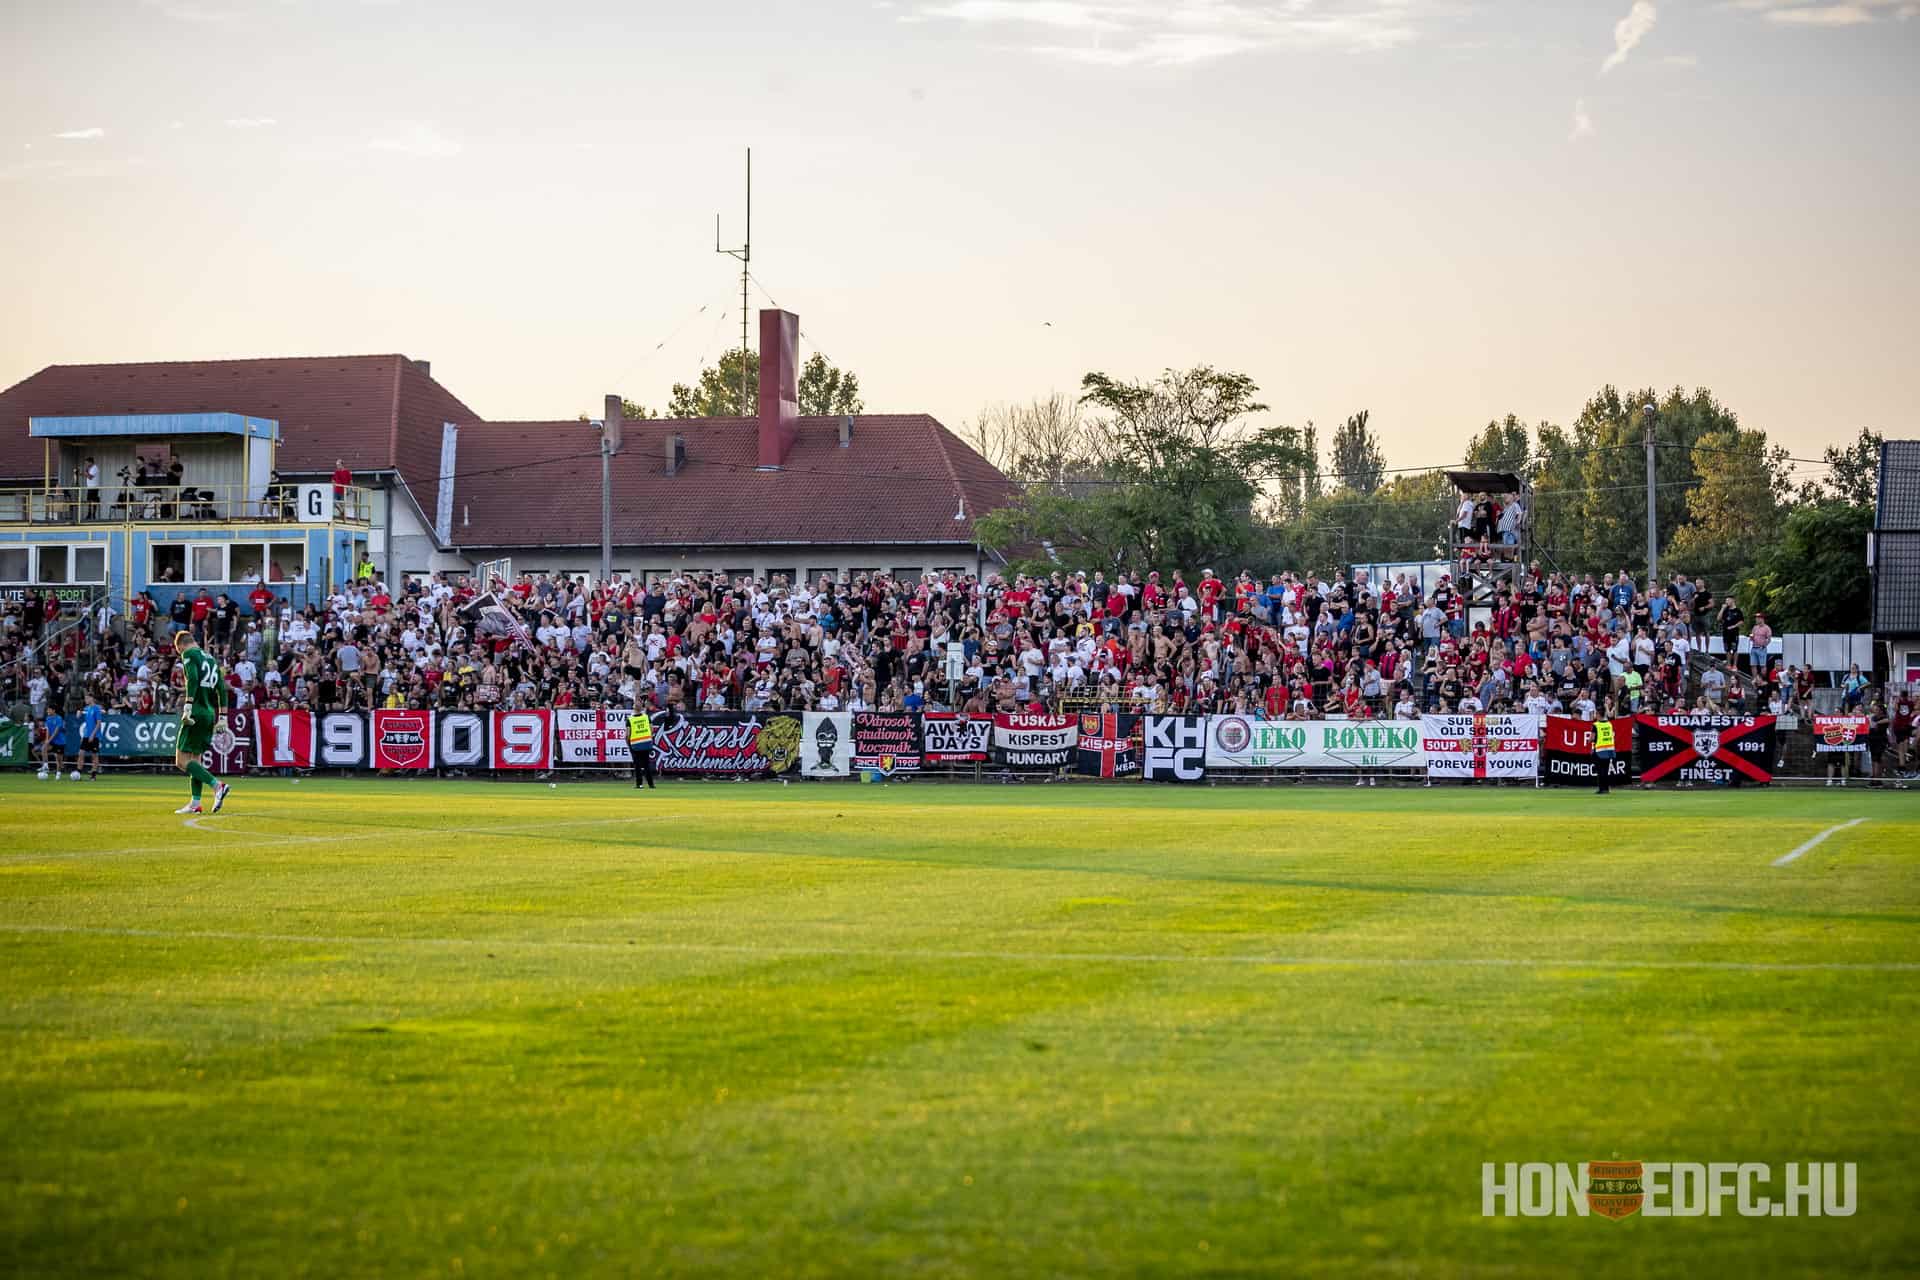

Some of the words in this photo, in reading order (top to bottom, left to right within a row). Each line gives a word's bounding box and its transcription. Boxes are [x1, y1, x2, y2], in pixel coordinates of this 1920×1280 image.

[308, 489, 322, 516] G
[200, 660, 218, 689] 26
[234, 713, 247, 732] 9
[570, 713, 597, 723] ONE
[1658, 715, 1755, 727] BUDAPEST'S
[564, 729, 609, 740] KISPEST
[651, 710, 763, 757] Kispest
[1144, 715, 1206, 748] KH
[1440, 726, 1465, 736] OLD
[1469, 726, 1520, 736] SCHOOL
[272, 713, 296, 763] 1
[321, 712, 366, 766] 9
[440, 713, 484, 766] 0
[501, 713, 545, 766] 9
[932, 736, 981, 750] DAYS
[1008, 733, 1067, 746] KISPEST
[1080, 737, 1129, 750] KISPES
[1253, 727, 1306, 750] EKO
[1324, 726, 1418, 750] RONEKO
[574, 746, 599, 757] ONE
[604, 746, 629, 757] LIFE
[1503, 740, 1534, 750] SPZL
[1648, 742, 1674, 752] EST.
[1737, 742, 1766, 752] 1991
[203, 750, 214, 769] 8
[234, 751, 245, 769] 4
[650, 746, 769, 770] Troublemakers
[1006, 751, 1069, 765] HUNGARY
[1143, 747, 1204, 780] FC
[1428, 759, 1485, 770] FOREVER
[1489, 759, 1533, 769] YOUNG
[1695, 760, 1717, 769] 40+
[1680, 769, 1733, 780] FINEST
